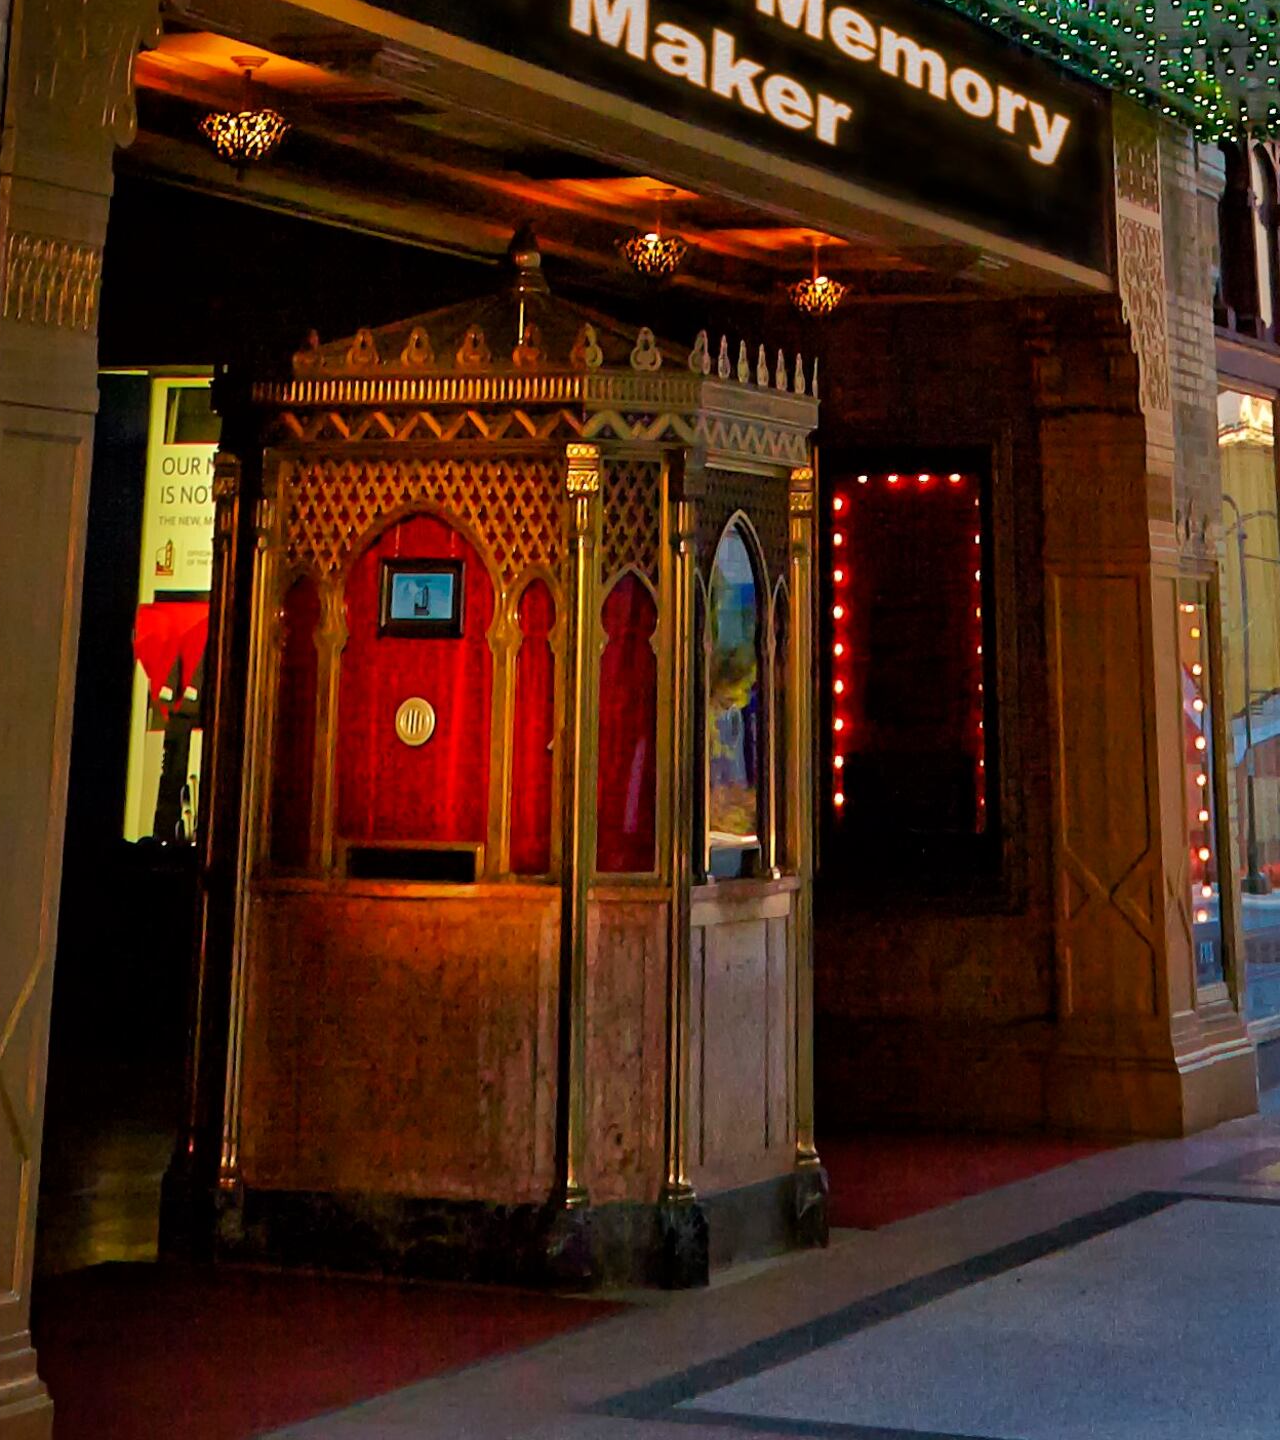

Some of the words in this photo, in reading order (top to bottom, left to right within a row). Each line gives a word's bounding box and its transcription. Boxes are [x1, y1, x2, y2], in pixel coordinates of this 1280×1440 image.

[162, 457, 200, 476] OUR
[160, 485, 175, 504] IS
[180, 485, 212, 504] NO
[159, 516, 176, 526] THE
